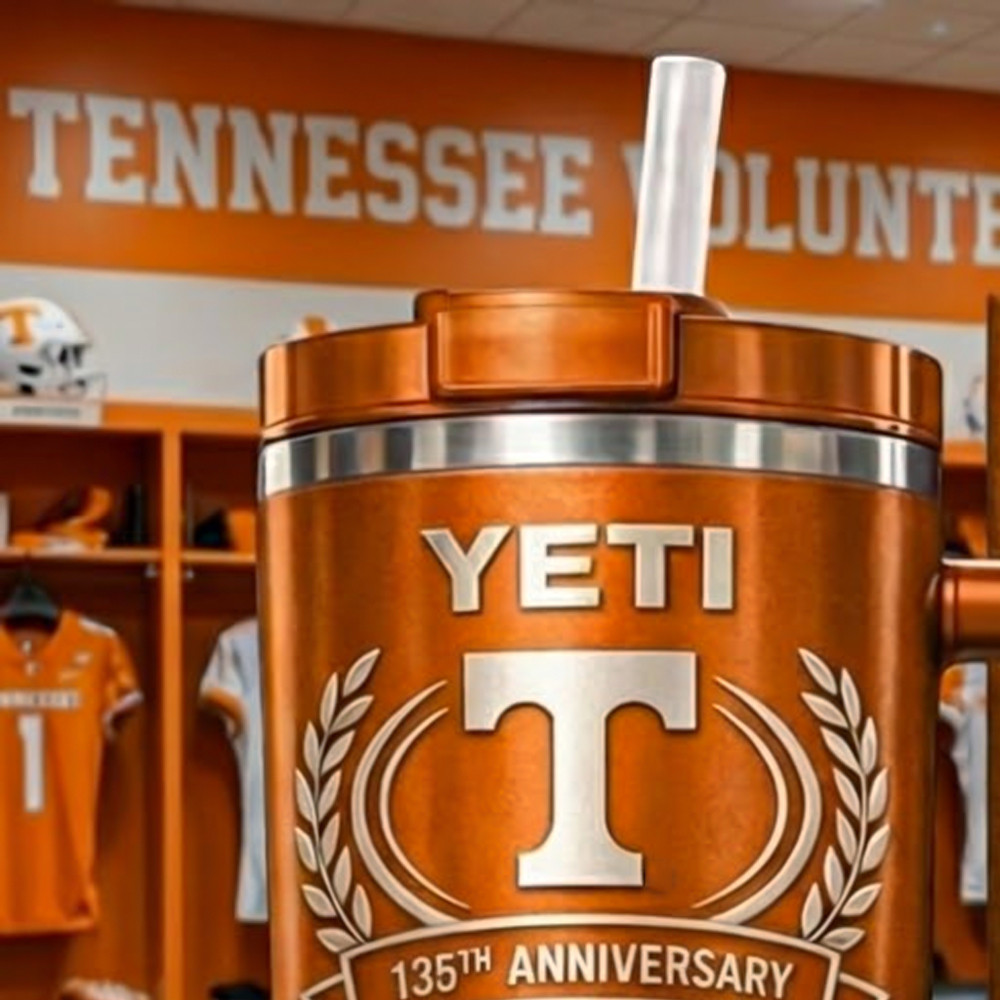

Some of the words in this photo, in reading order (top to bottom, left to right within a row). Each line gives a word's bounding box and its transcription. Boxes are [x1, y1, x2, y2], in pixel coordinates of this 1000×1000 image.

[9, 88, 593, 236] TENNESSEE
[420, 523, 735, 613] YETI
[19, 713, 43, 812] 1
[463, 651, 697, 887] T
[391, 945, 492, 1000] 135TH
[507, 944, 794, 999] ANNIVERSARY
